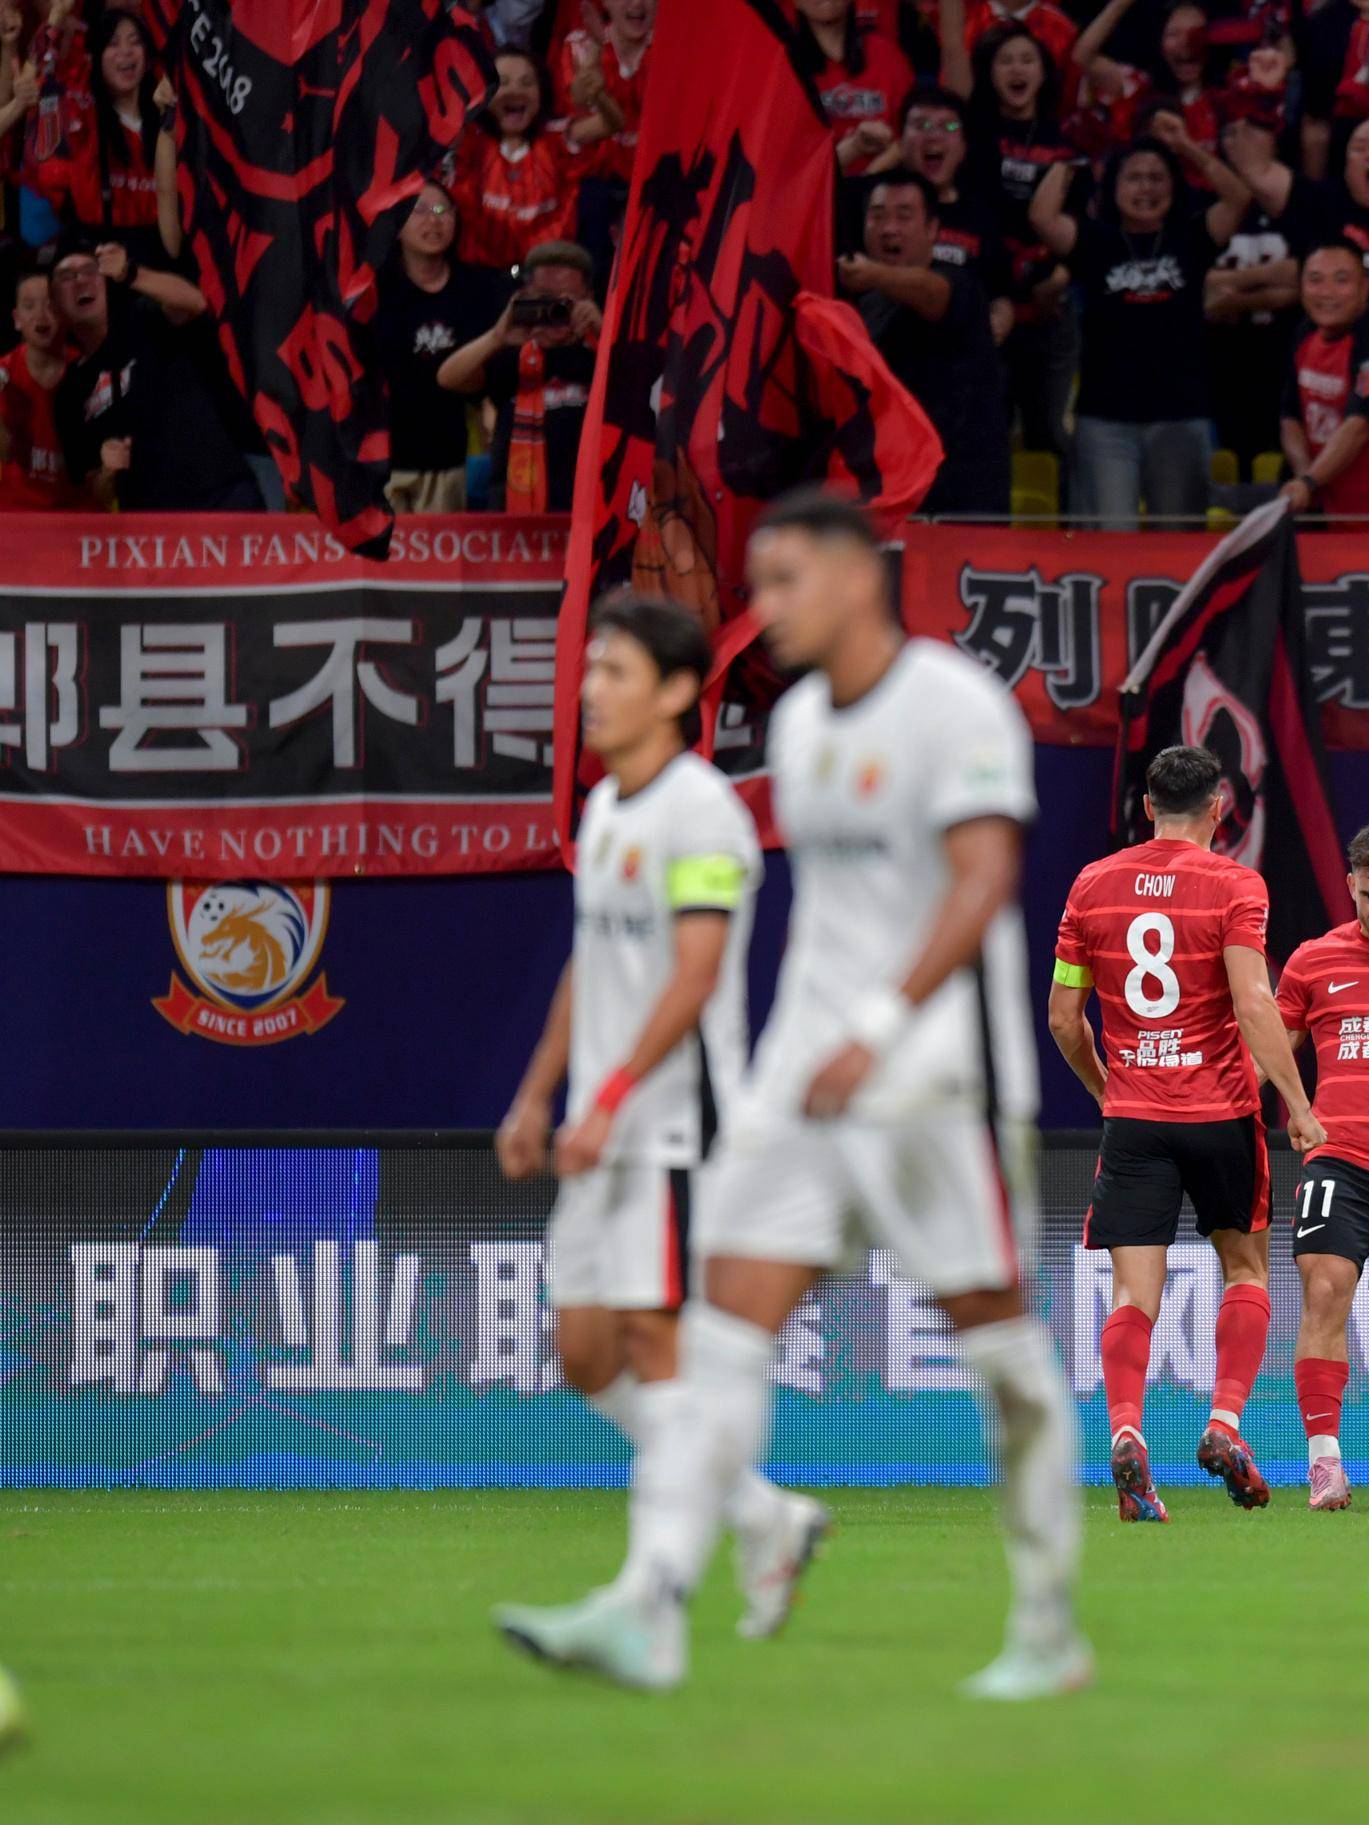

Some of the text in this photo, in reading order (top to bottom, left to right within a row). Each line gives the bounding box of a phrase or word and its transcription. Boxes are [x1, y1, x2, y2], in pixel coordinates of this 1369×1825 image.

[80, 530, 570, 569] PIXIAN FANS SSOCIAT
[84, 825, 206, 859] HAVE
[219, 823, 439, 860] NOTHING
[451, 823, 511, 855] TO
[1134, 873, 1176, 897] CHOW
[1124, 912, 1180, 1019] 8
[198, 1008, 298, 1037] SINCE 2007
[1137, 1029, 1184, 1040] PISEN
[1300, 1179, 1335, 1219] 11
